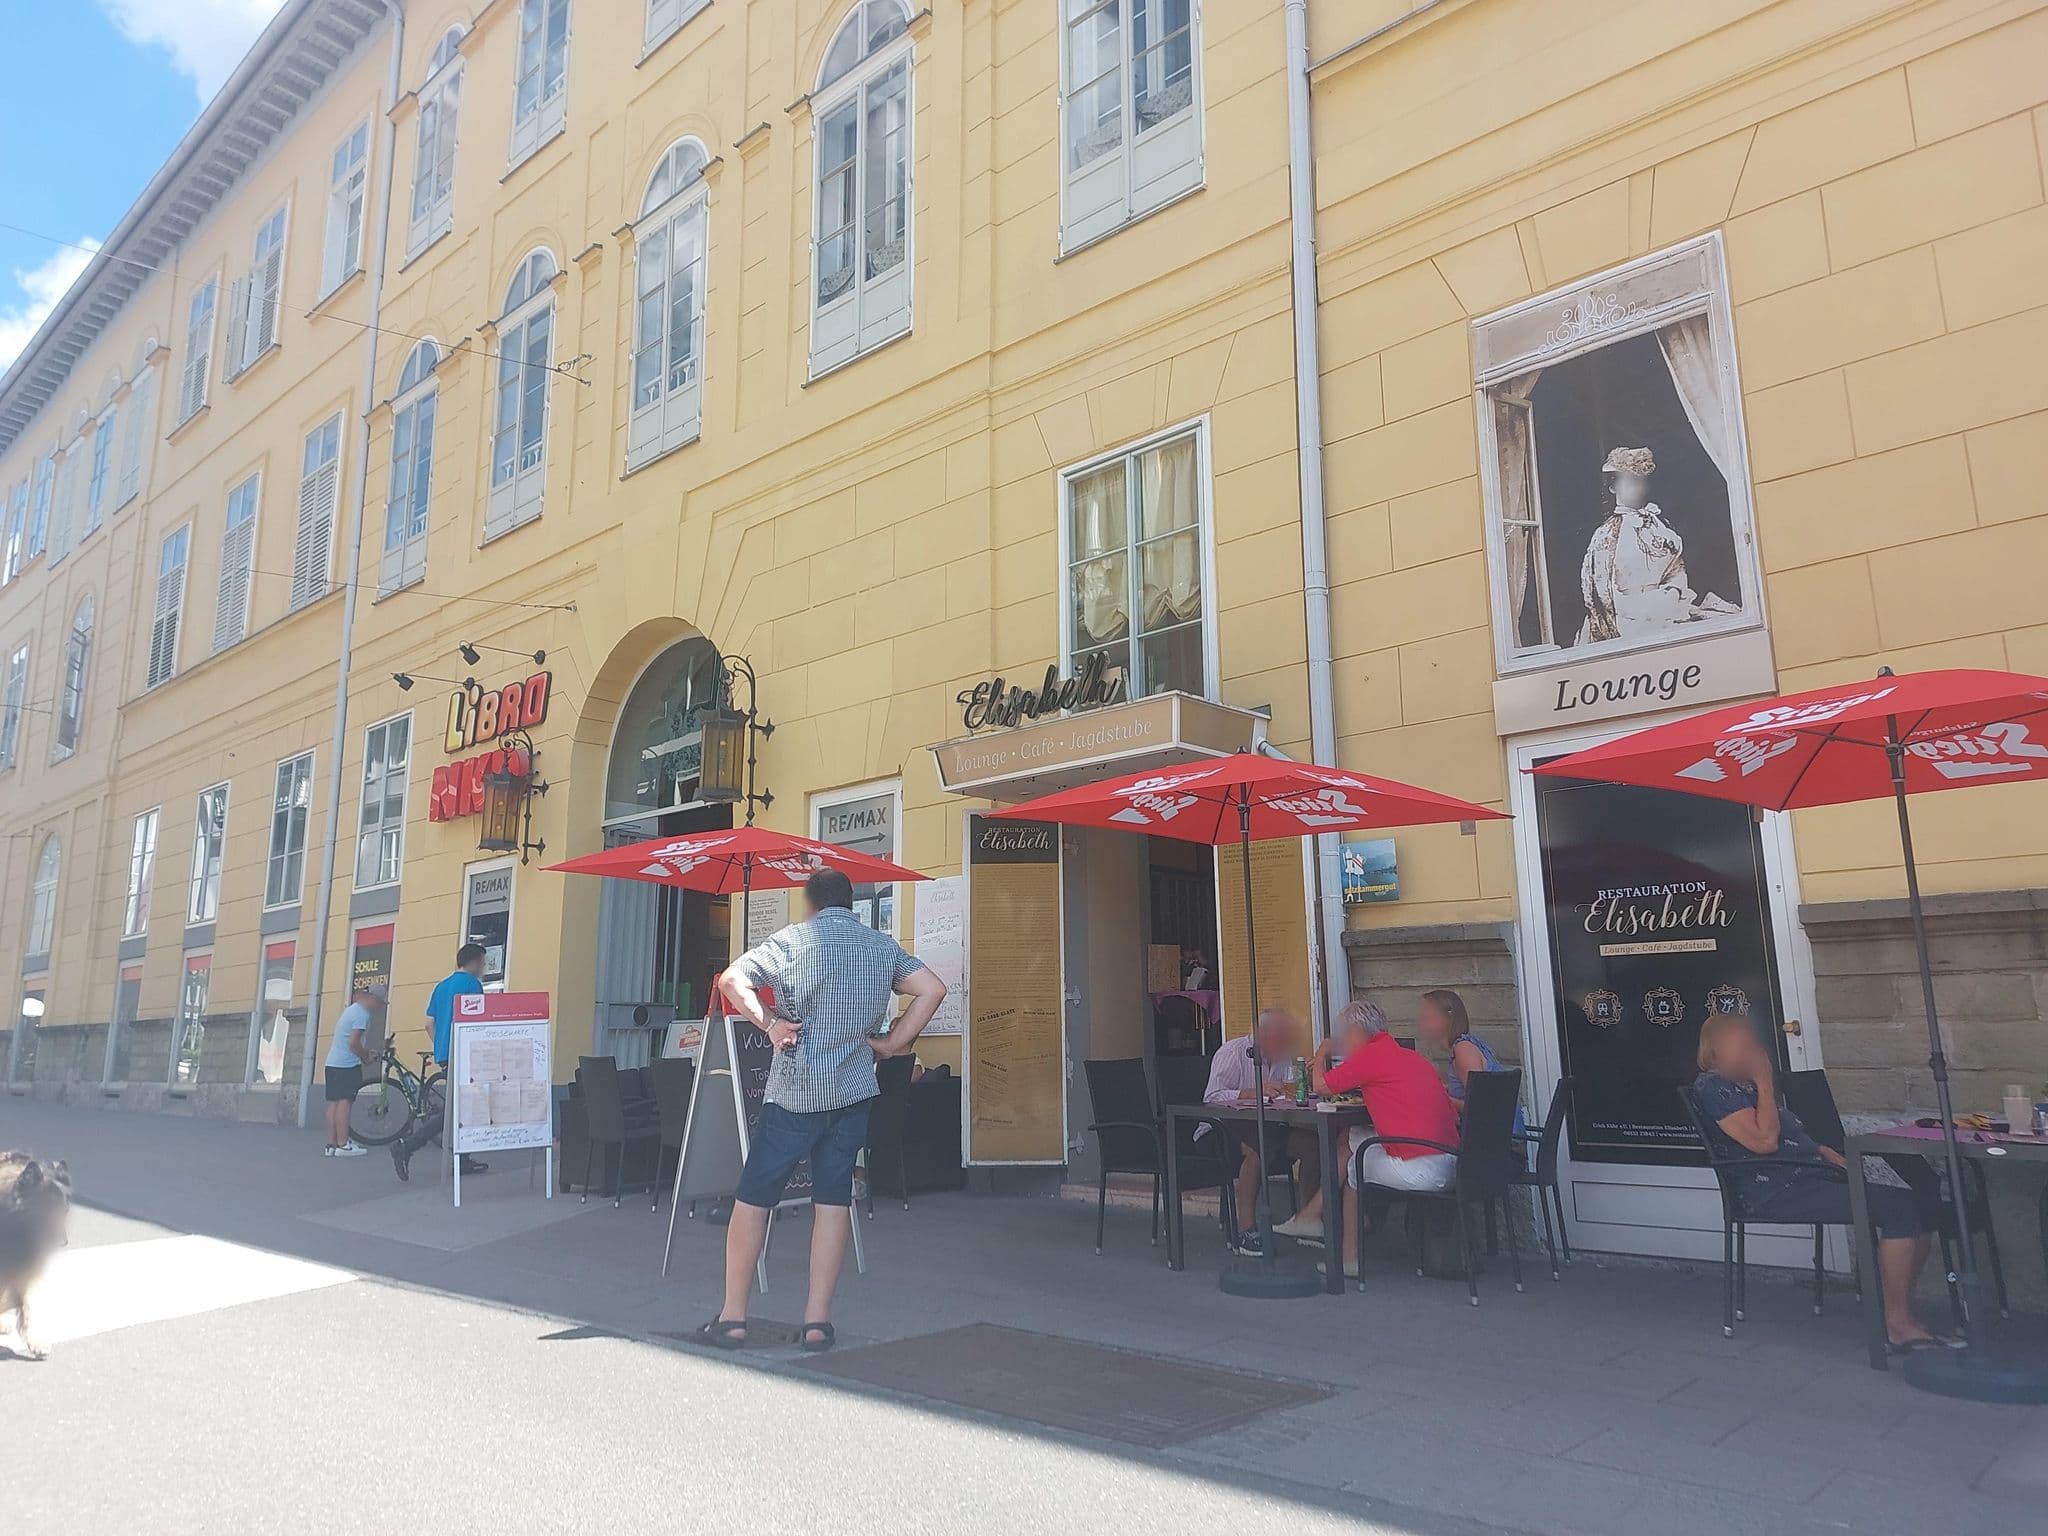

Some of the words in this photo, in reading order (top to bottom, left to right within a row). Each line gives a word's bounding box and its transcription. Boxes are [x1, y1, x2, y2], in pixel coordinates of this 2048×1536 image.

[957, 650, 1124, 731] Elisabeth
[1553, 662, 1702, 712] Lounge
[954, 749, 1007, 774] Lounge
[1020, 738, 1055, 760] Café
[1070, 719, 1153, 751] Jagdstube
[828, 806, 887, 834] RE/MAX
[988, 826, 1040, 834] RESTAURATION
[976, 830, 1055, 851] Elisabeth
[475, 876, 509, 895] RE/MAX
[1597, 881, 1707, 900] RESTAURATION
[1574, 889, 1737, 936] Elisabeth
[1603, 946, 1635, 955] Lounge
[1668, 941, 1713, 952] Jagdstube
[355, 959, 379, 973] SCHULE
[353, 974, 388, 990] SCHENKEN
